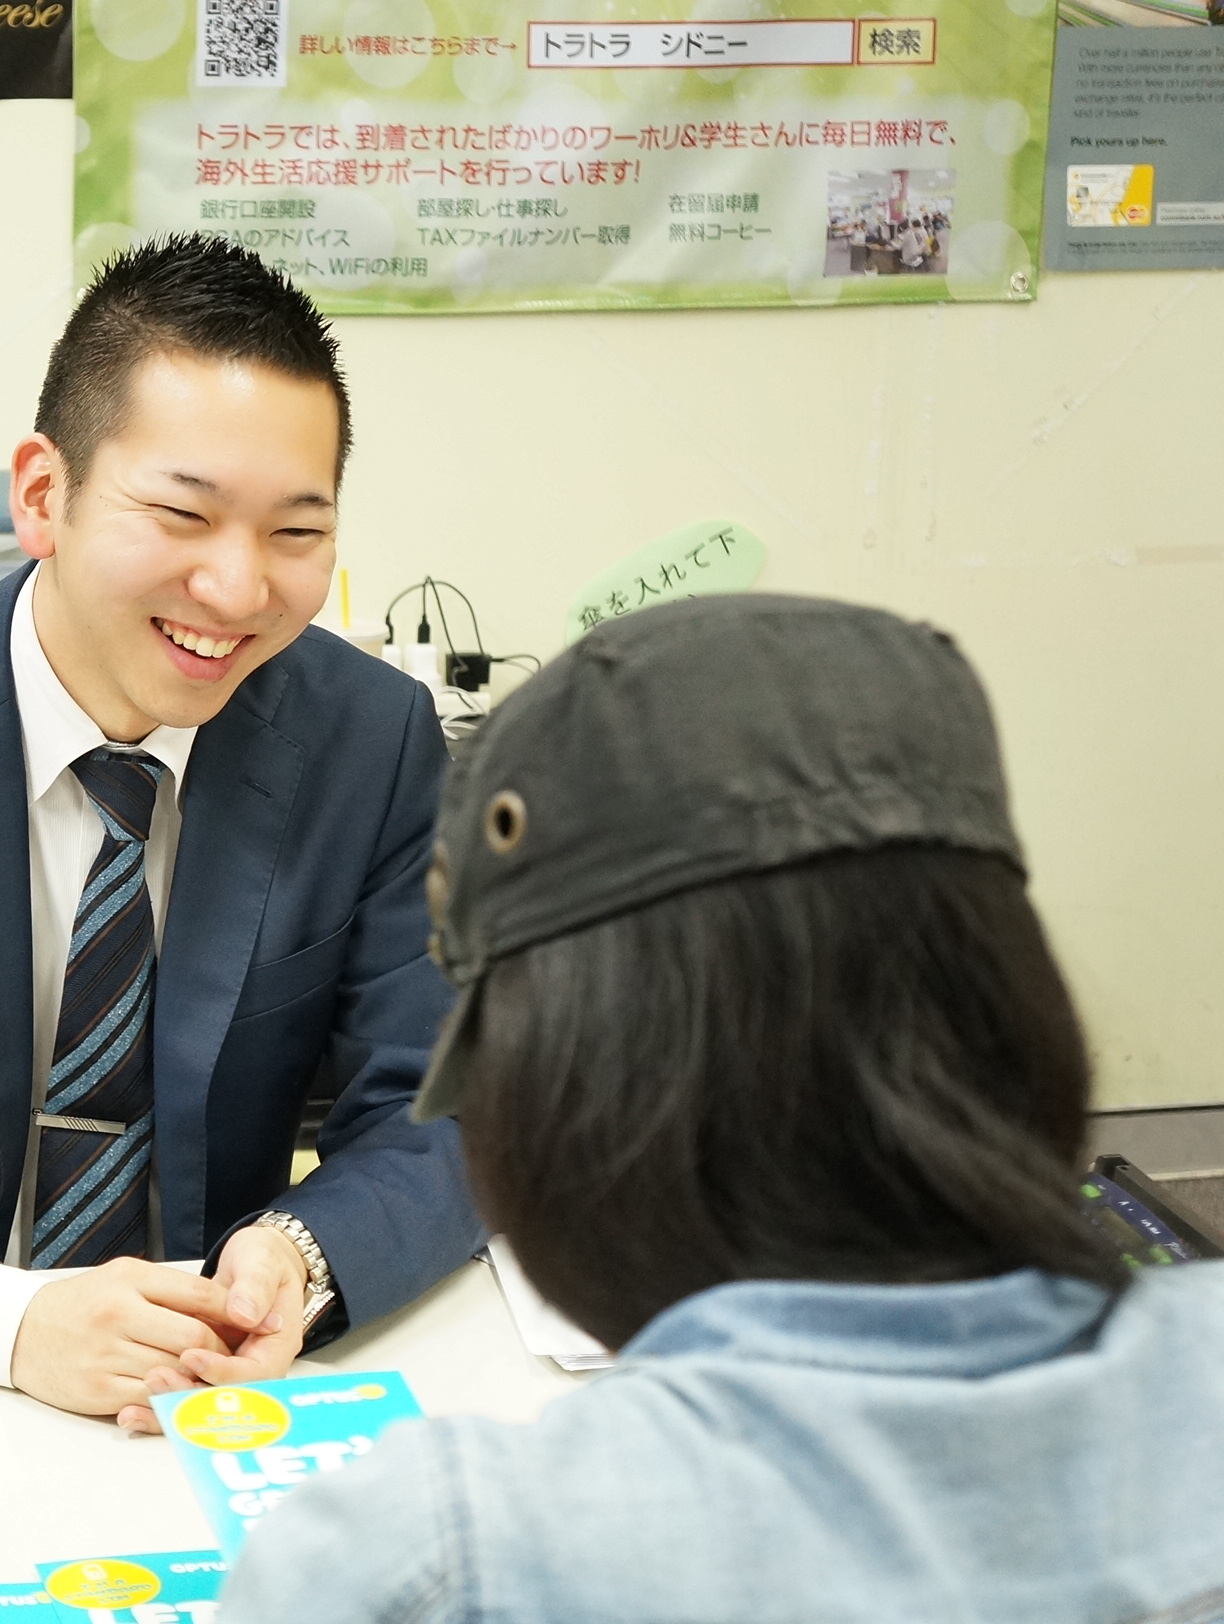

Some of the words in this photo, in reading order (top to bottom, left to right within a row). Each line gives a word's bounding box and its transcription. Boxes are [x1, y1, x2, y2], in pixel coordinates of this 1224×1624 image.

[544, 31, 632, 59] トラトラ
[660, 31, 748, 58] シドニー
[868, 28, 922, 56] 検索
[1070, 136, 1092, 148] Pick
[1094, 136, 1124, 148] yours
[1126, 136, 1140, 148] up
[200, 198, 316, 219] 銀行口座開設
[668, 221, 772, 243] 無料コーヒー
